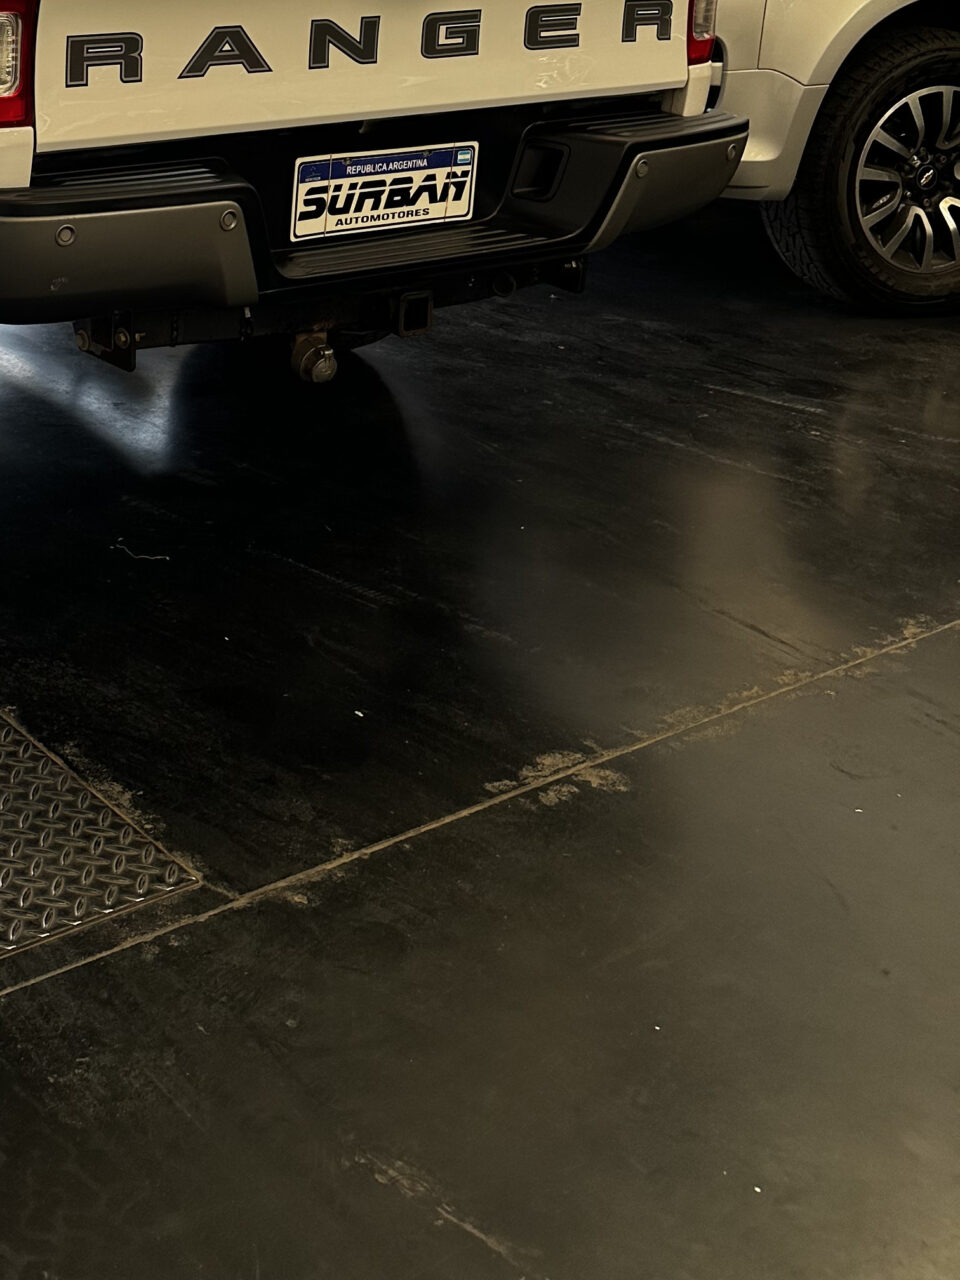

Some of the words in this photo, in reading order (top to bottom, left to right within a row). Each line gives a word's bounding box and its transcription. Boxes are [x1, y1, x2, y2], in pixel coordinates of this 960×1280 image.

[388, 158, 428, 171] ARGENTINA
[297, 169, 471, 222] SURBAN
[334, 207, 430, 227] AUTOMOTORES
